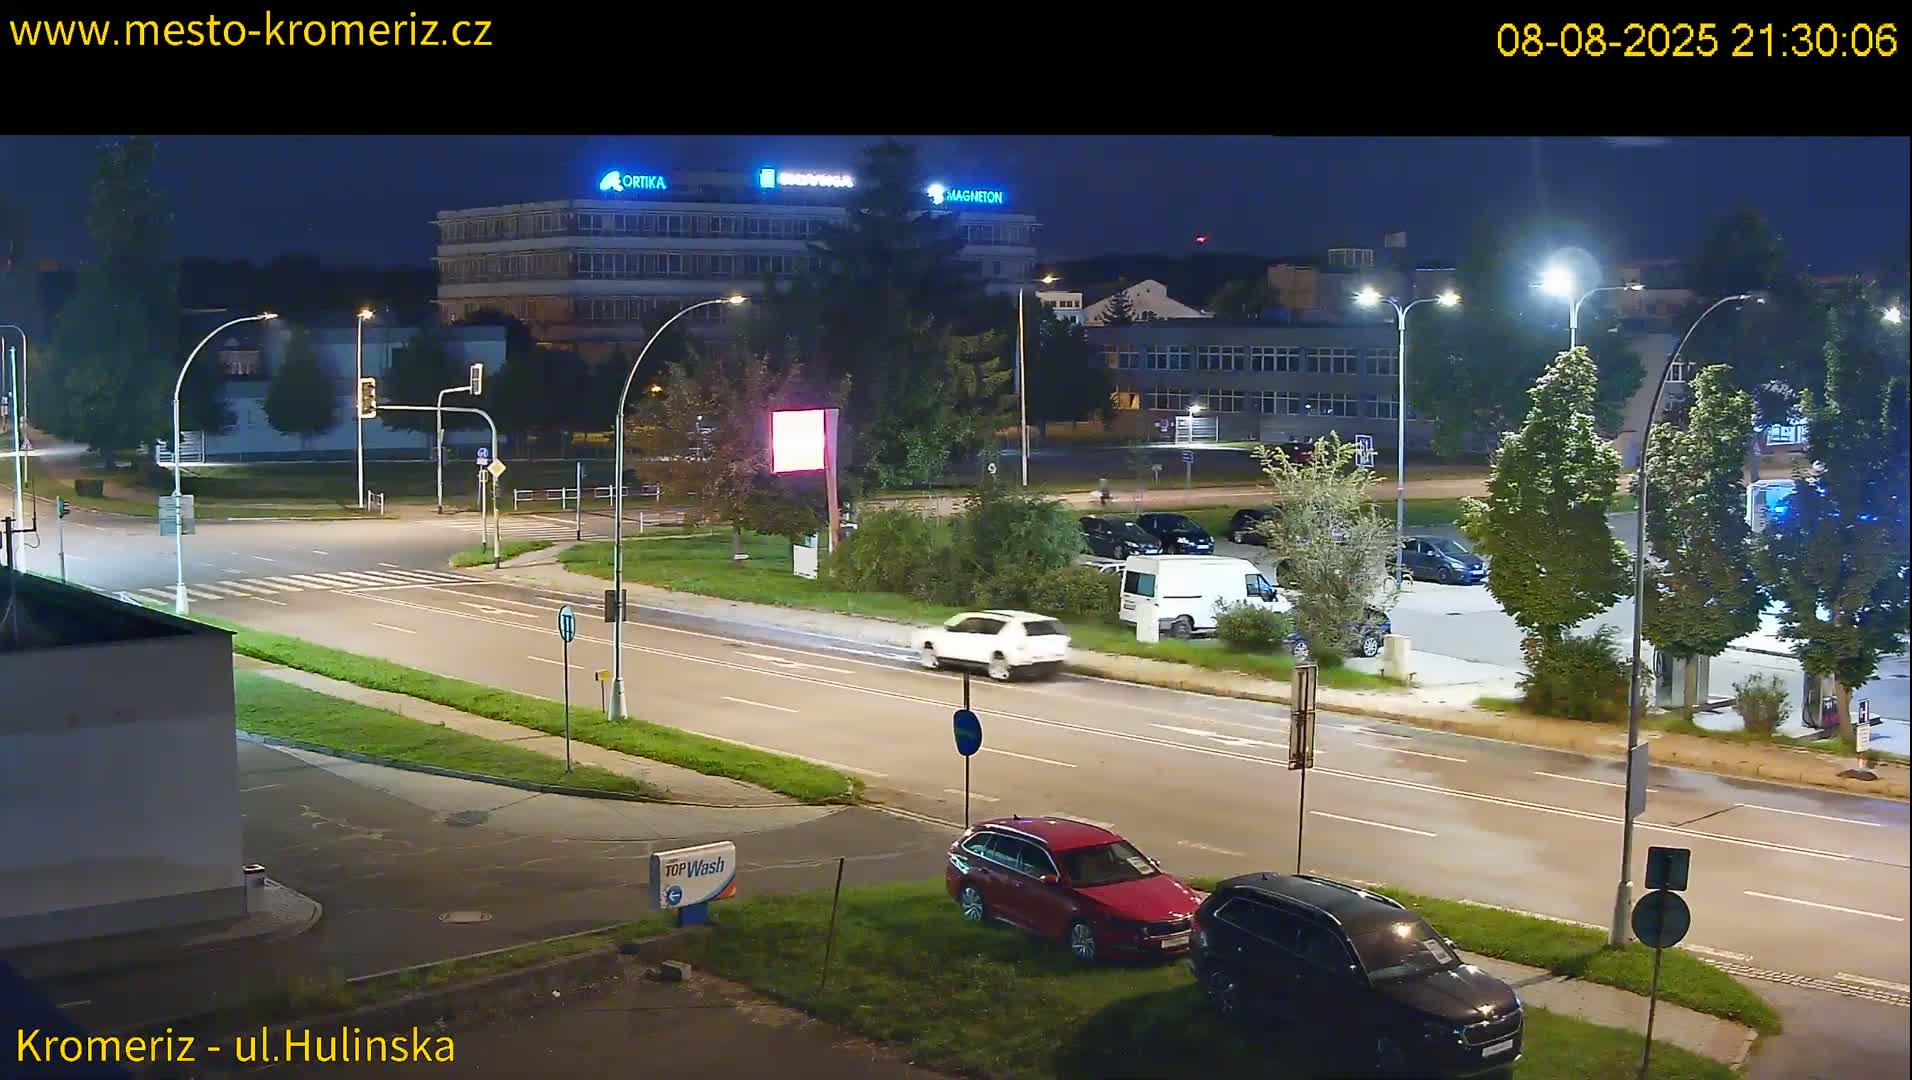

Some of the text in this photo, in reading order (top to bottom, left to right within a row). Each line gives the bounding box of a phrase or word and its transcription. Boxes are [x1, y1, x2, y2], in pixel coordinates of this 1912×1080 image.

[622, 174, 667, 190] ORTIKA
[946, 188, 1003, 204] MAGNETON
[665, 856, 724, 878] TOP Wash
